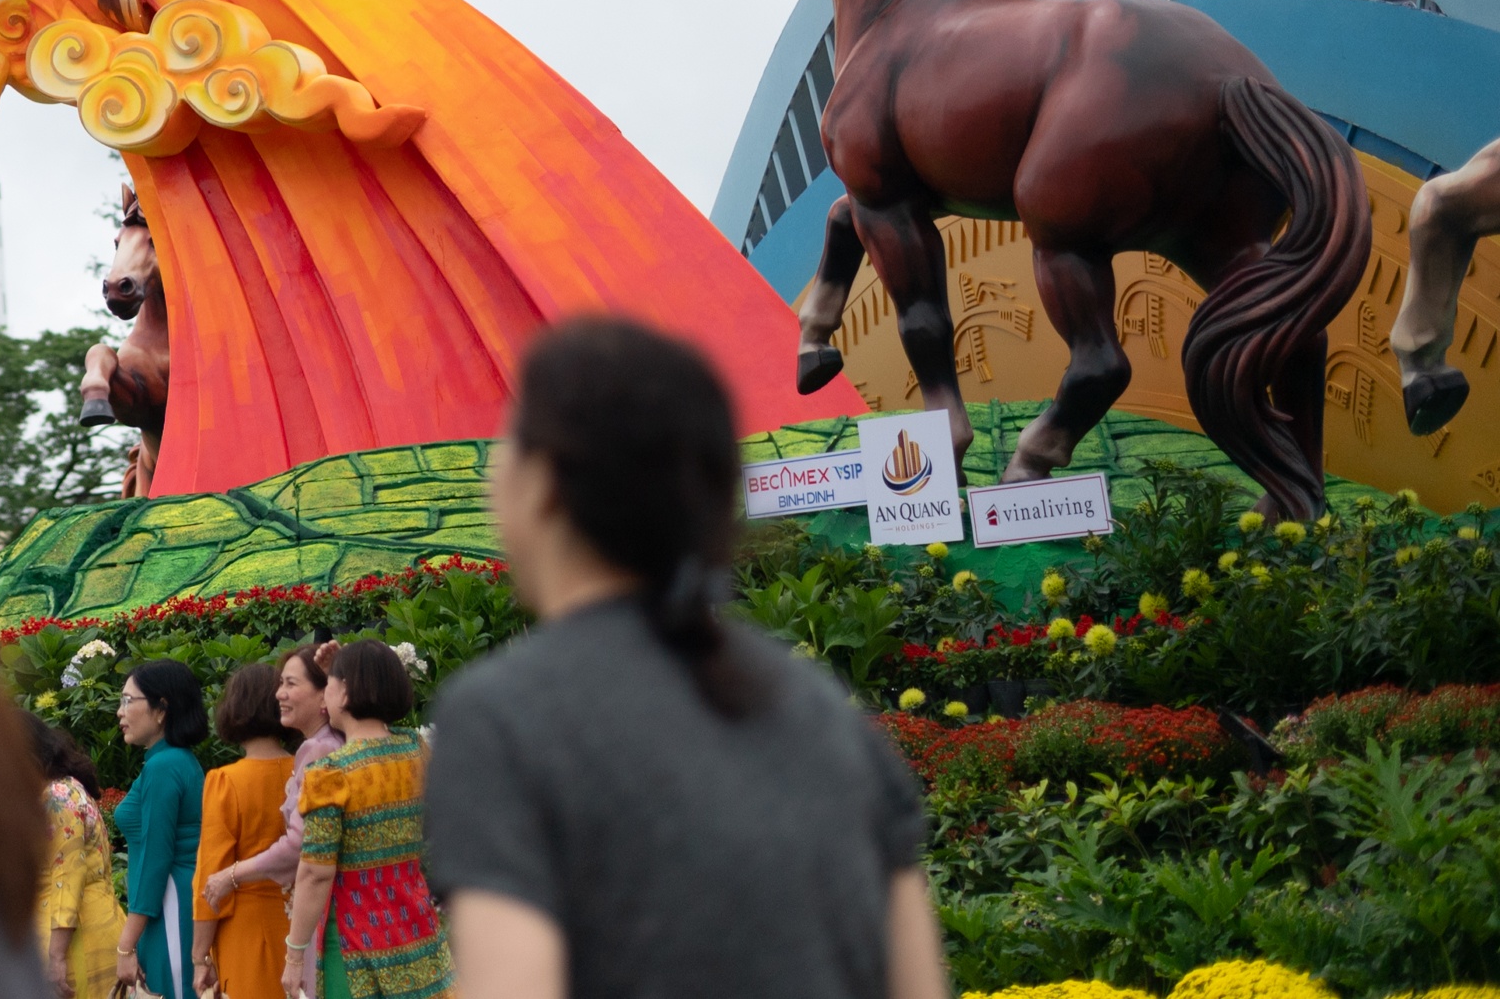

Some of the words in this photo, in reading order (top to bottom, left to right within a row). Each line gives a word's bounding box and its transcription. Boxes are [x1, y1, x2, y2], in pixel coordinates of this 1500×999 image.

[749, 466, 830, 493] BECAMEX
[833, 463, 863, 480] VSIP
[778, 491, 805, 508] BINH
[1003, 497, 1095, 522] vinaliving
[875, 505, 897, 523] AN
[900, 500, 951, 520] QUANG
[895, 522, 935, 532] HOLDINGS
